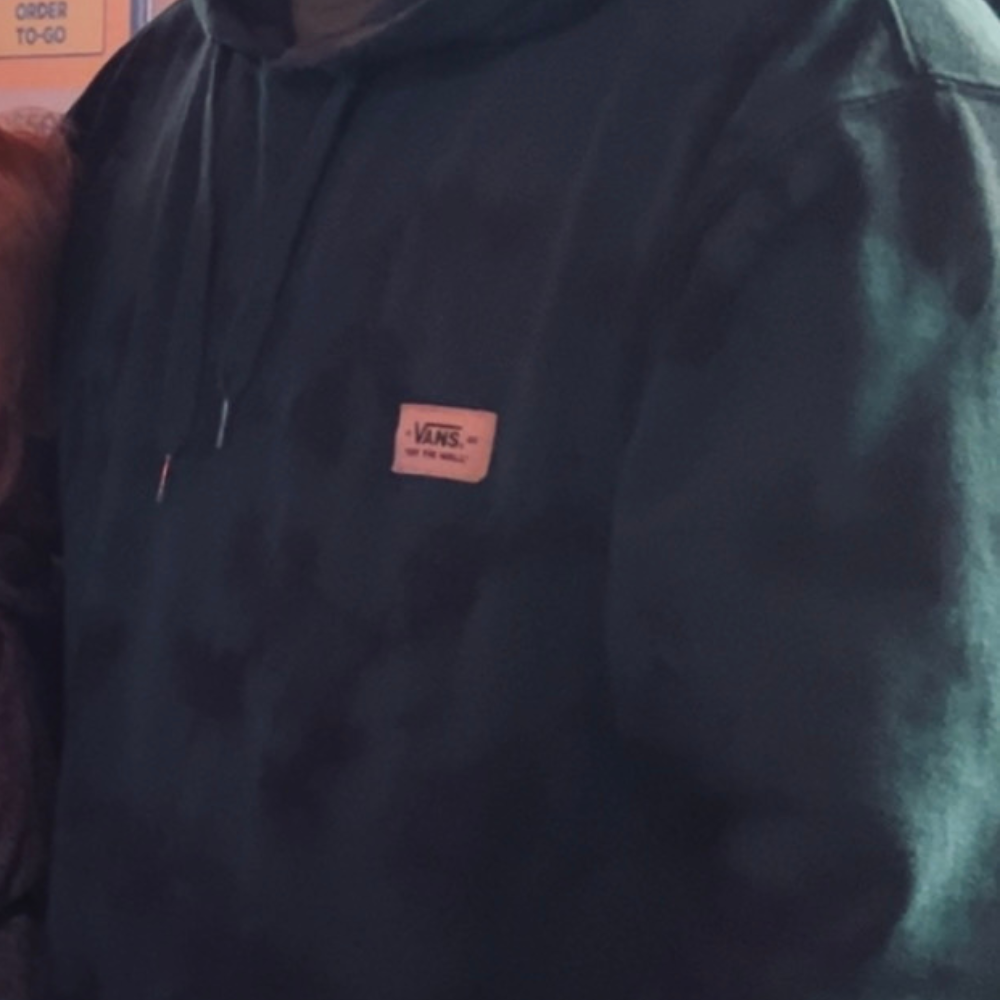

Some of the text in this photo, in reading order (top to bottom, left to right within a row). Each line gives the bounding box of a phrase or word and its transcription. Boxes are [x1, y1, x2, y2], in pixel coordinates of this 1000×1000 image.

[15, 1, 67, 21] ORDER
[16, 26, 66, 45] TO-GO
[414, 421, 463, 448] VANS
